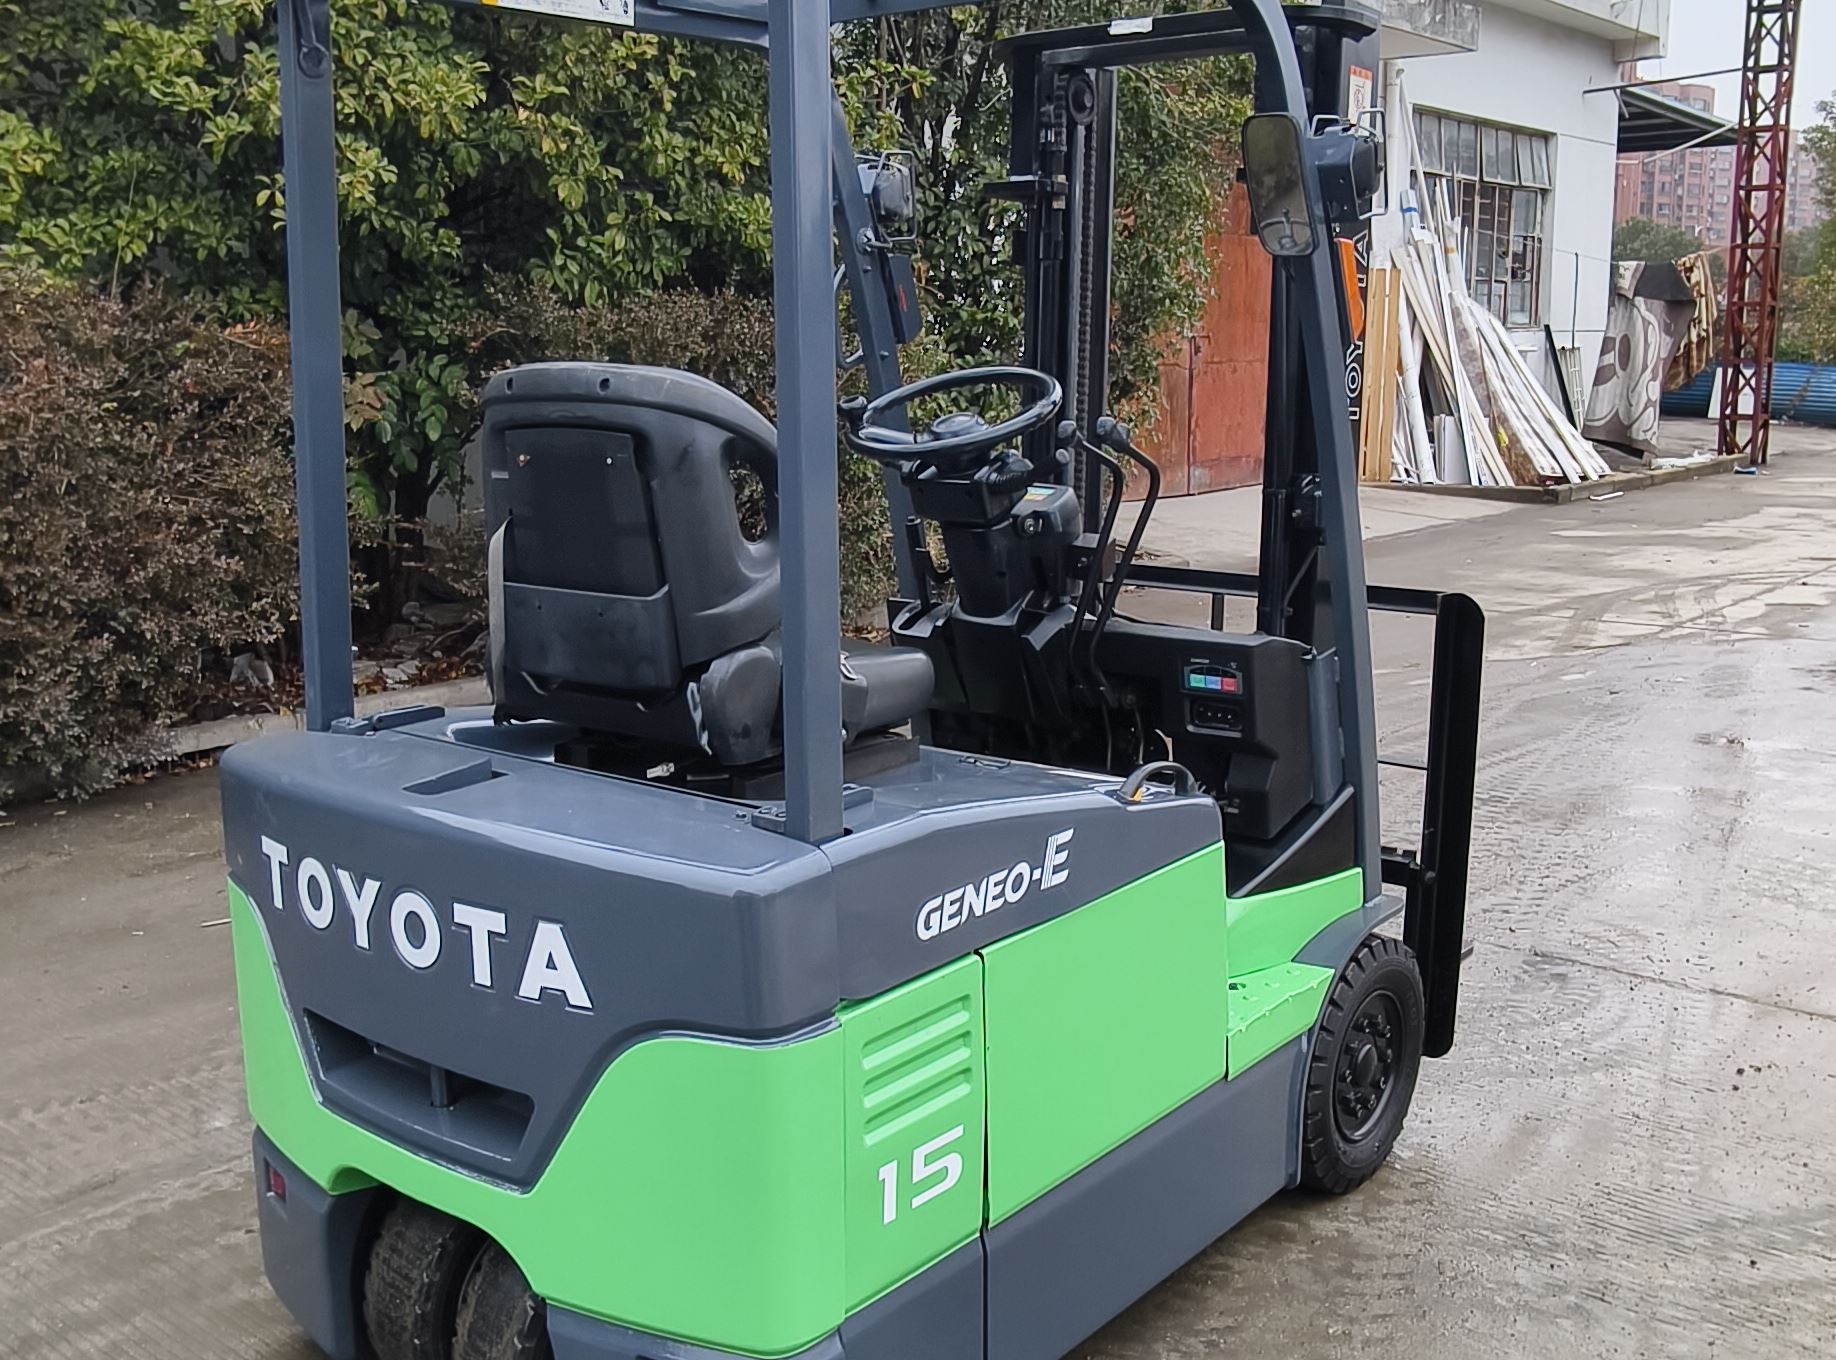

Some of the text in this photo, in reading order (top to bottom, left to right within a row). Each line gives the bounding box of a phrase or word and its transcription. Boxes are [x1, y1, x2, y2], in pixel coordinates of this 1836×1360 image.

[1345, 229, 1369, 420] OYA
[261, 835, 593, 1010] TOYOTA
[916, 827, 1074, 941] GENEO-E
[878, 1123, 964, 1225] 15
